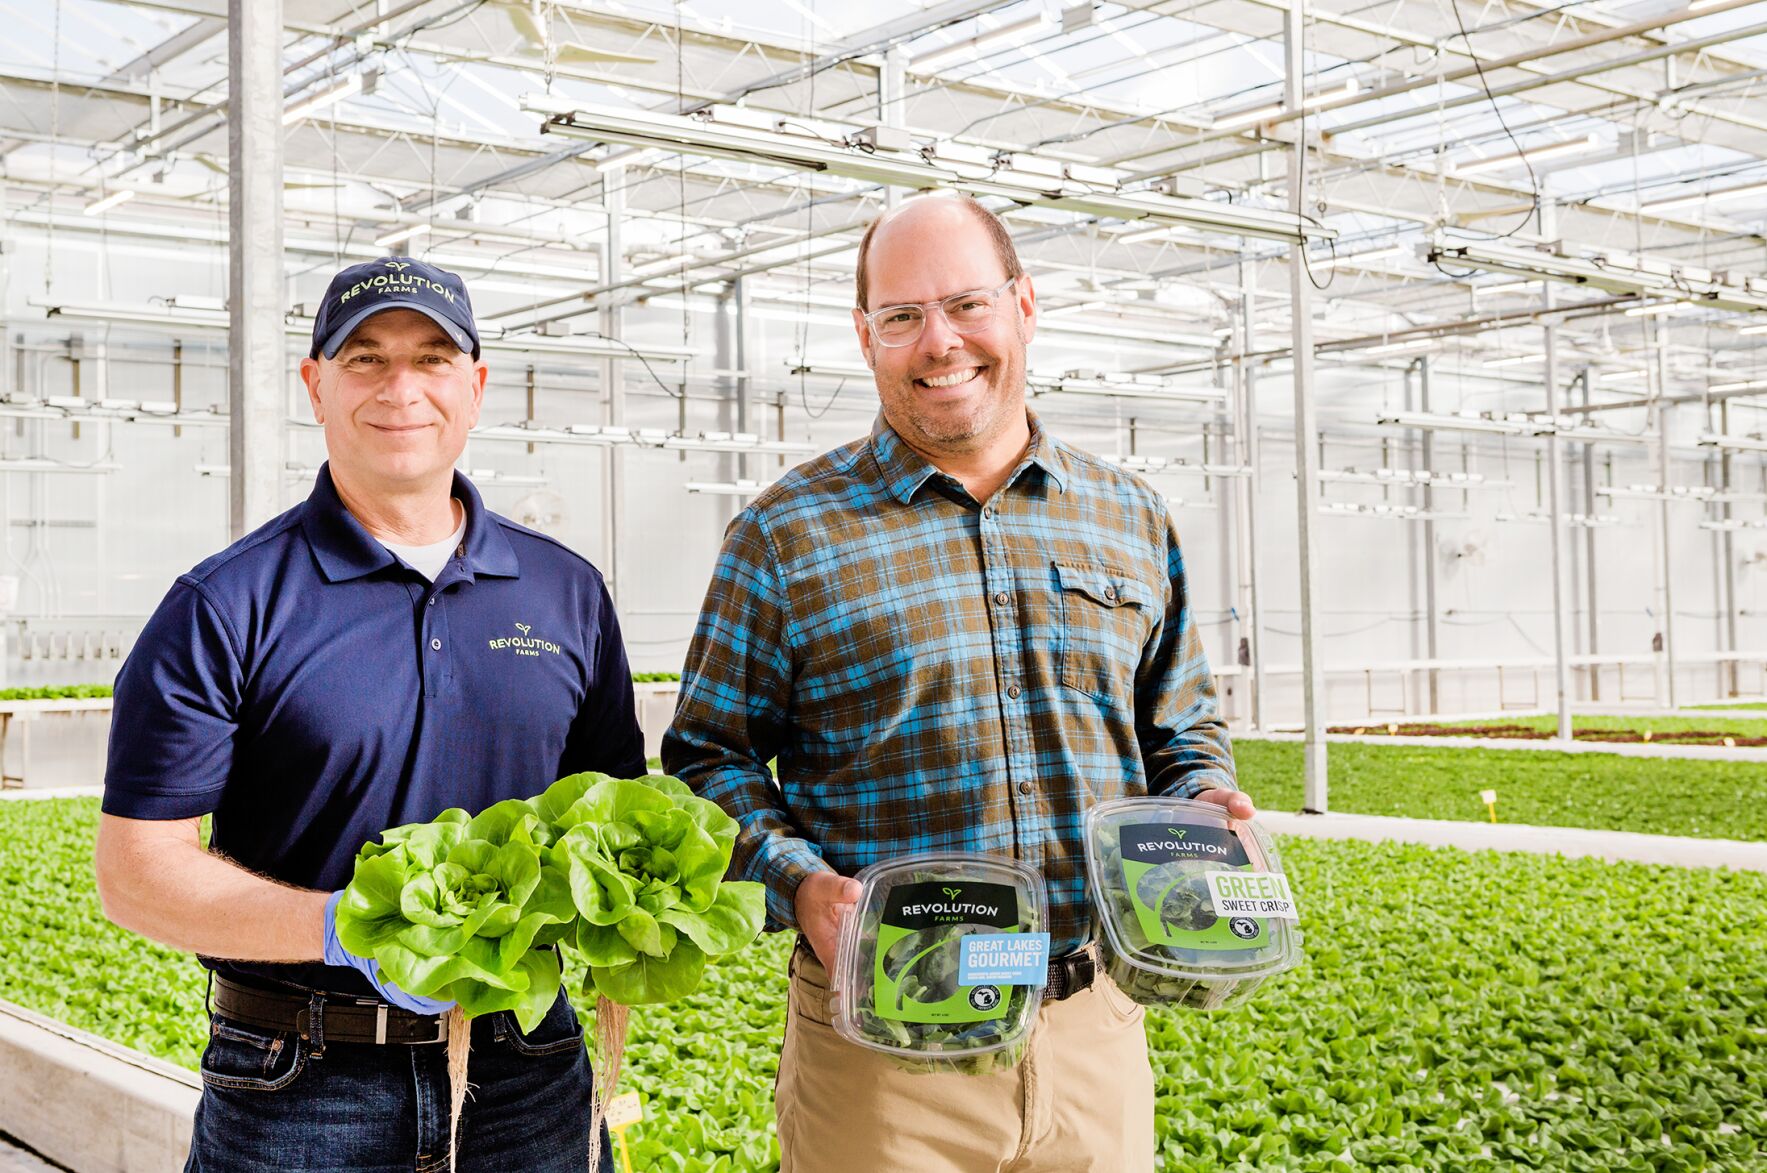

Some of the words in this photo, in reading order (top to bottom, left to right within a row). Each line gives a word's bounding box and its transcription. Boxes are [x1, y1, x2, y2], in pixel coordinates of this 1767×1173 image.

[341, 273, 456, 304] REVOLUTION
[378, 286, 418, 294] FARMS
[489, 637, 560, 655] REVOLUTION
[1136, 841, 1228, 856] REVOLUTION
[1216, 875, 1287, 900] GREEN
[902, 903, 998, 917] REVOLUTION
[1222, 900, 1258, 911] SWEET
[1260, 900, 1290, 912] CRISP
[969, 940, 1004, 952] GREAT
[1007, 940, 1042, 951] LAKES
[968, 952, 1042, 968] GOURMET
